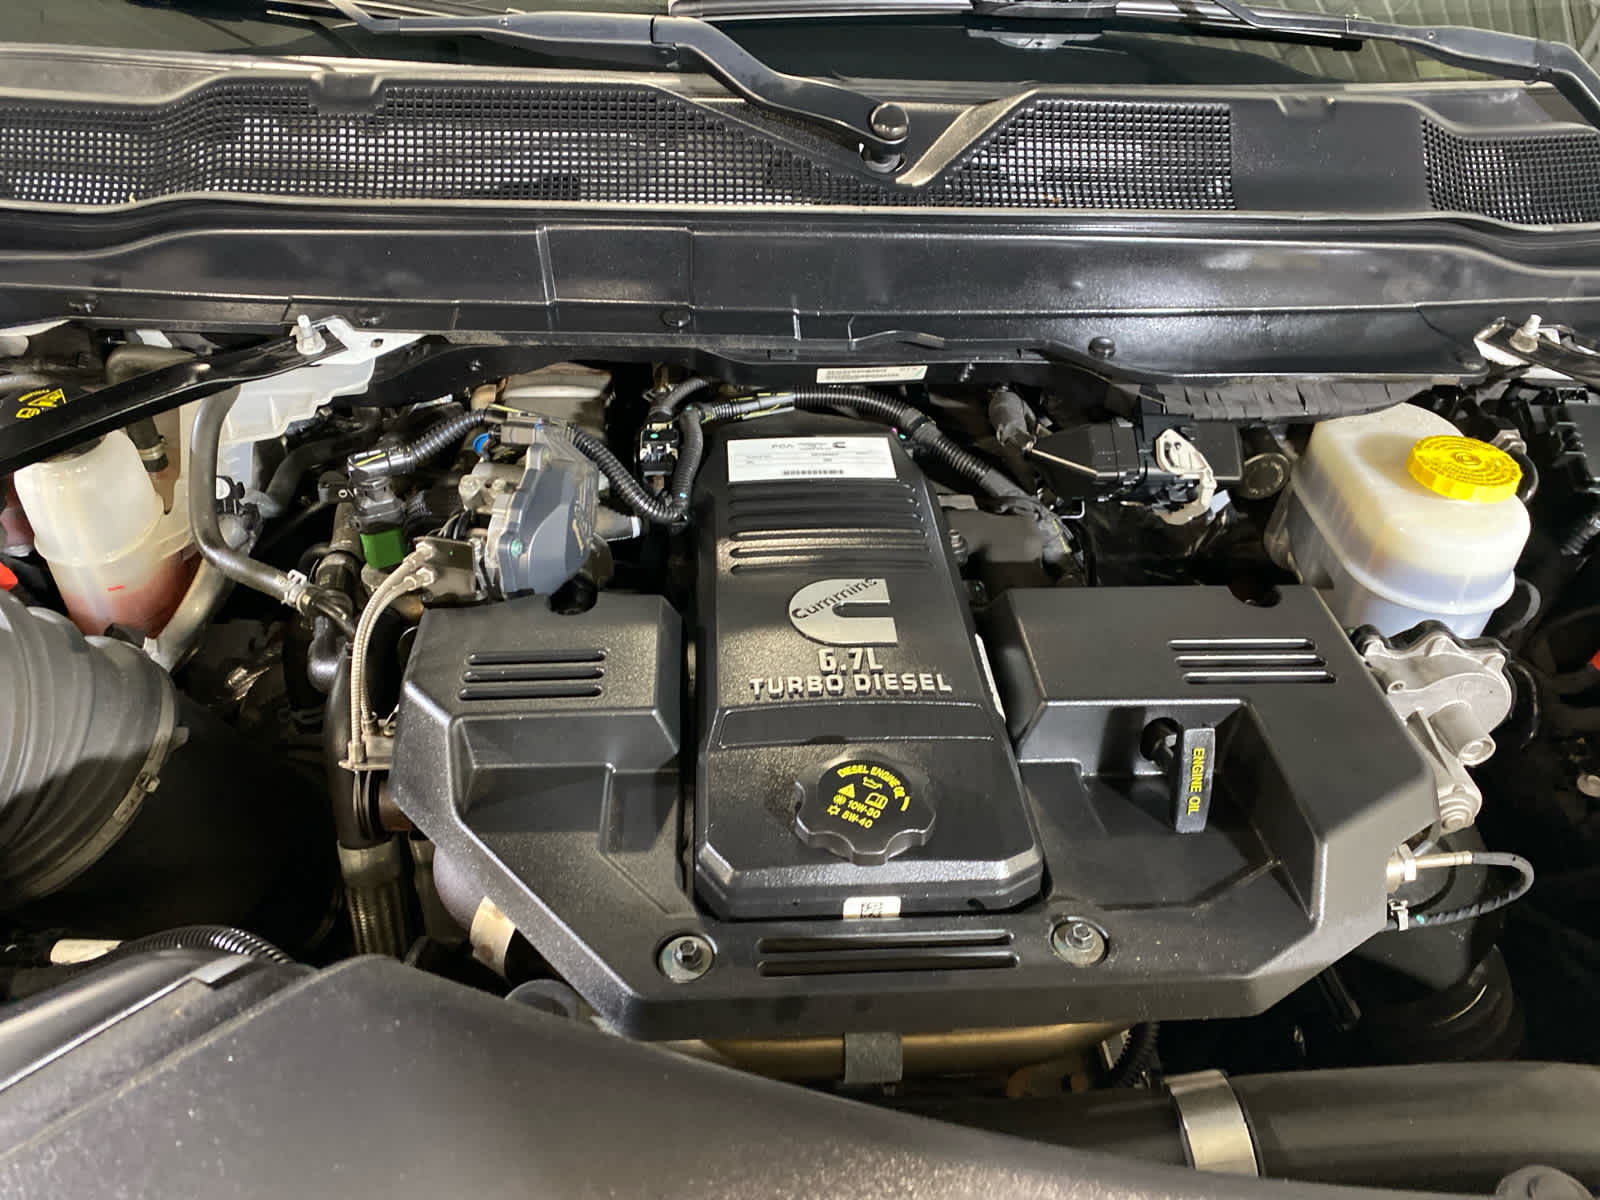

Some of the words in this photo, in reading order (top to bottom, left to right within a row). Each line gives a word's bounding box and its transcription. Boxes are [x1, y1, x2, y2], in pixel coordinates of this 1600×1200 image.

[791, 577, 878, 620] Cummins
[818, 648, 884, 674] 6.7L
[750, 675, 844, 699] TURBO
[853, 673, 952, 696] DIESEL
[836, 764, 869, 778] DIESEL
[870, 766, 901, 788] ENGINE
[1190, 747, 1206, 793] ENGINE
[1187, 796, 1201, 816] OIL
